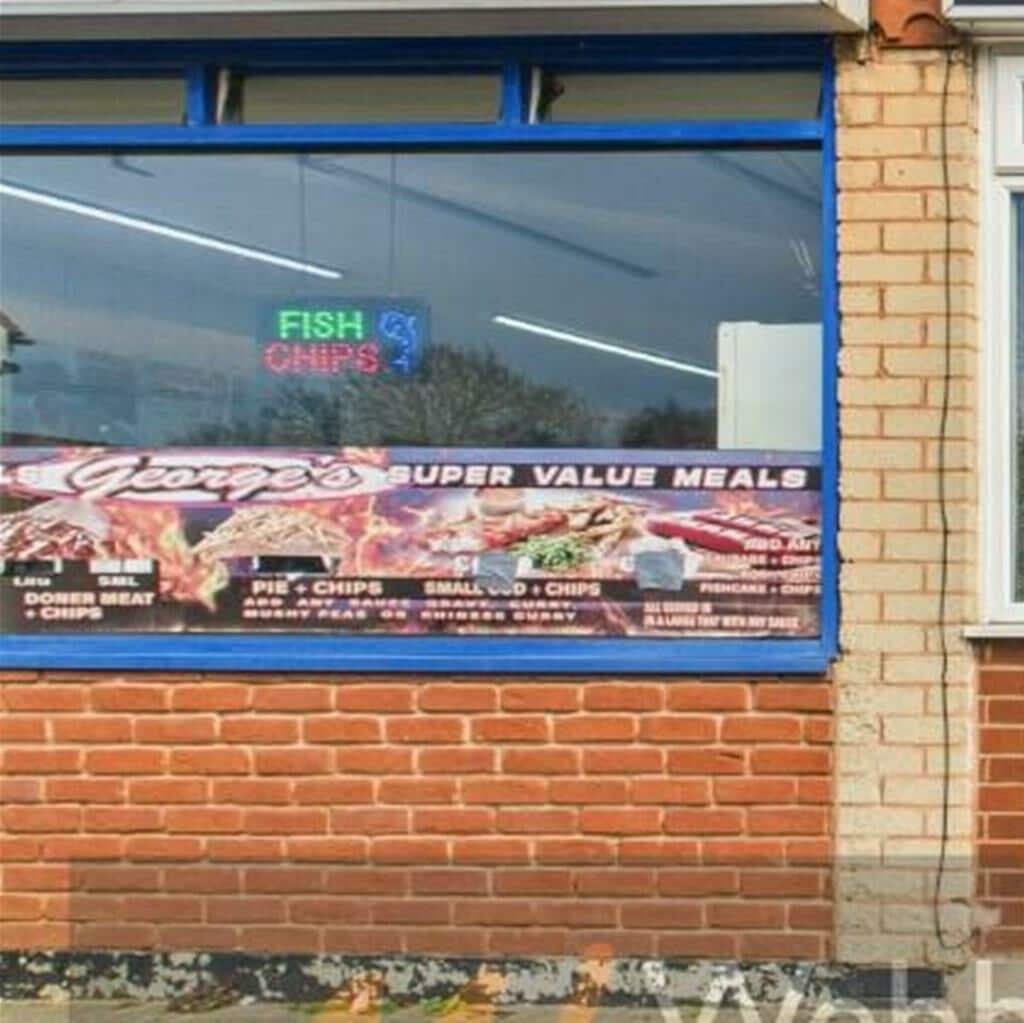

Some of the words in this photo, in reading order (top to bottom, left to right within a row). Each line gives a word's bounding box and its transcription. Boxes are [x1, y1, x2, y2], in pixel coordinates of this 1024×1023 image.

[278, 308, 364, 340] FISH
[262, 341, 382, 374] CHIPS
[67, 455, 364, 501] George's
[389, 465, 513, 487] SUPER
[533, 466, 656, 487] VALUE
[673, 467, 808, 489] MEALS
[252, 580, 289, 595] PIE
[312, 580, 383, 595] CHIPS
[423, 580, 483, 595] SMALL
[545, 581, 601, 596] CHIPS
[24, 592, 95, 605] DONER
[100, 592, 155, 605] MEAT
[39, 606, 103, 620] CHIPS
